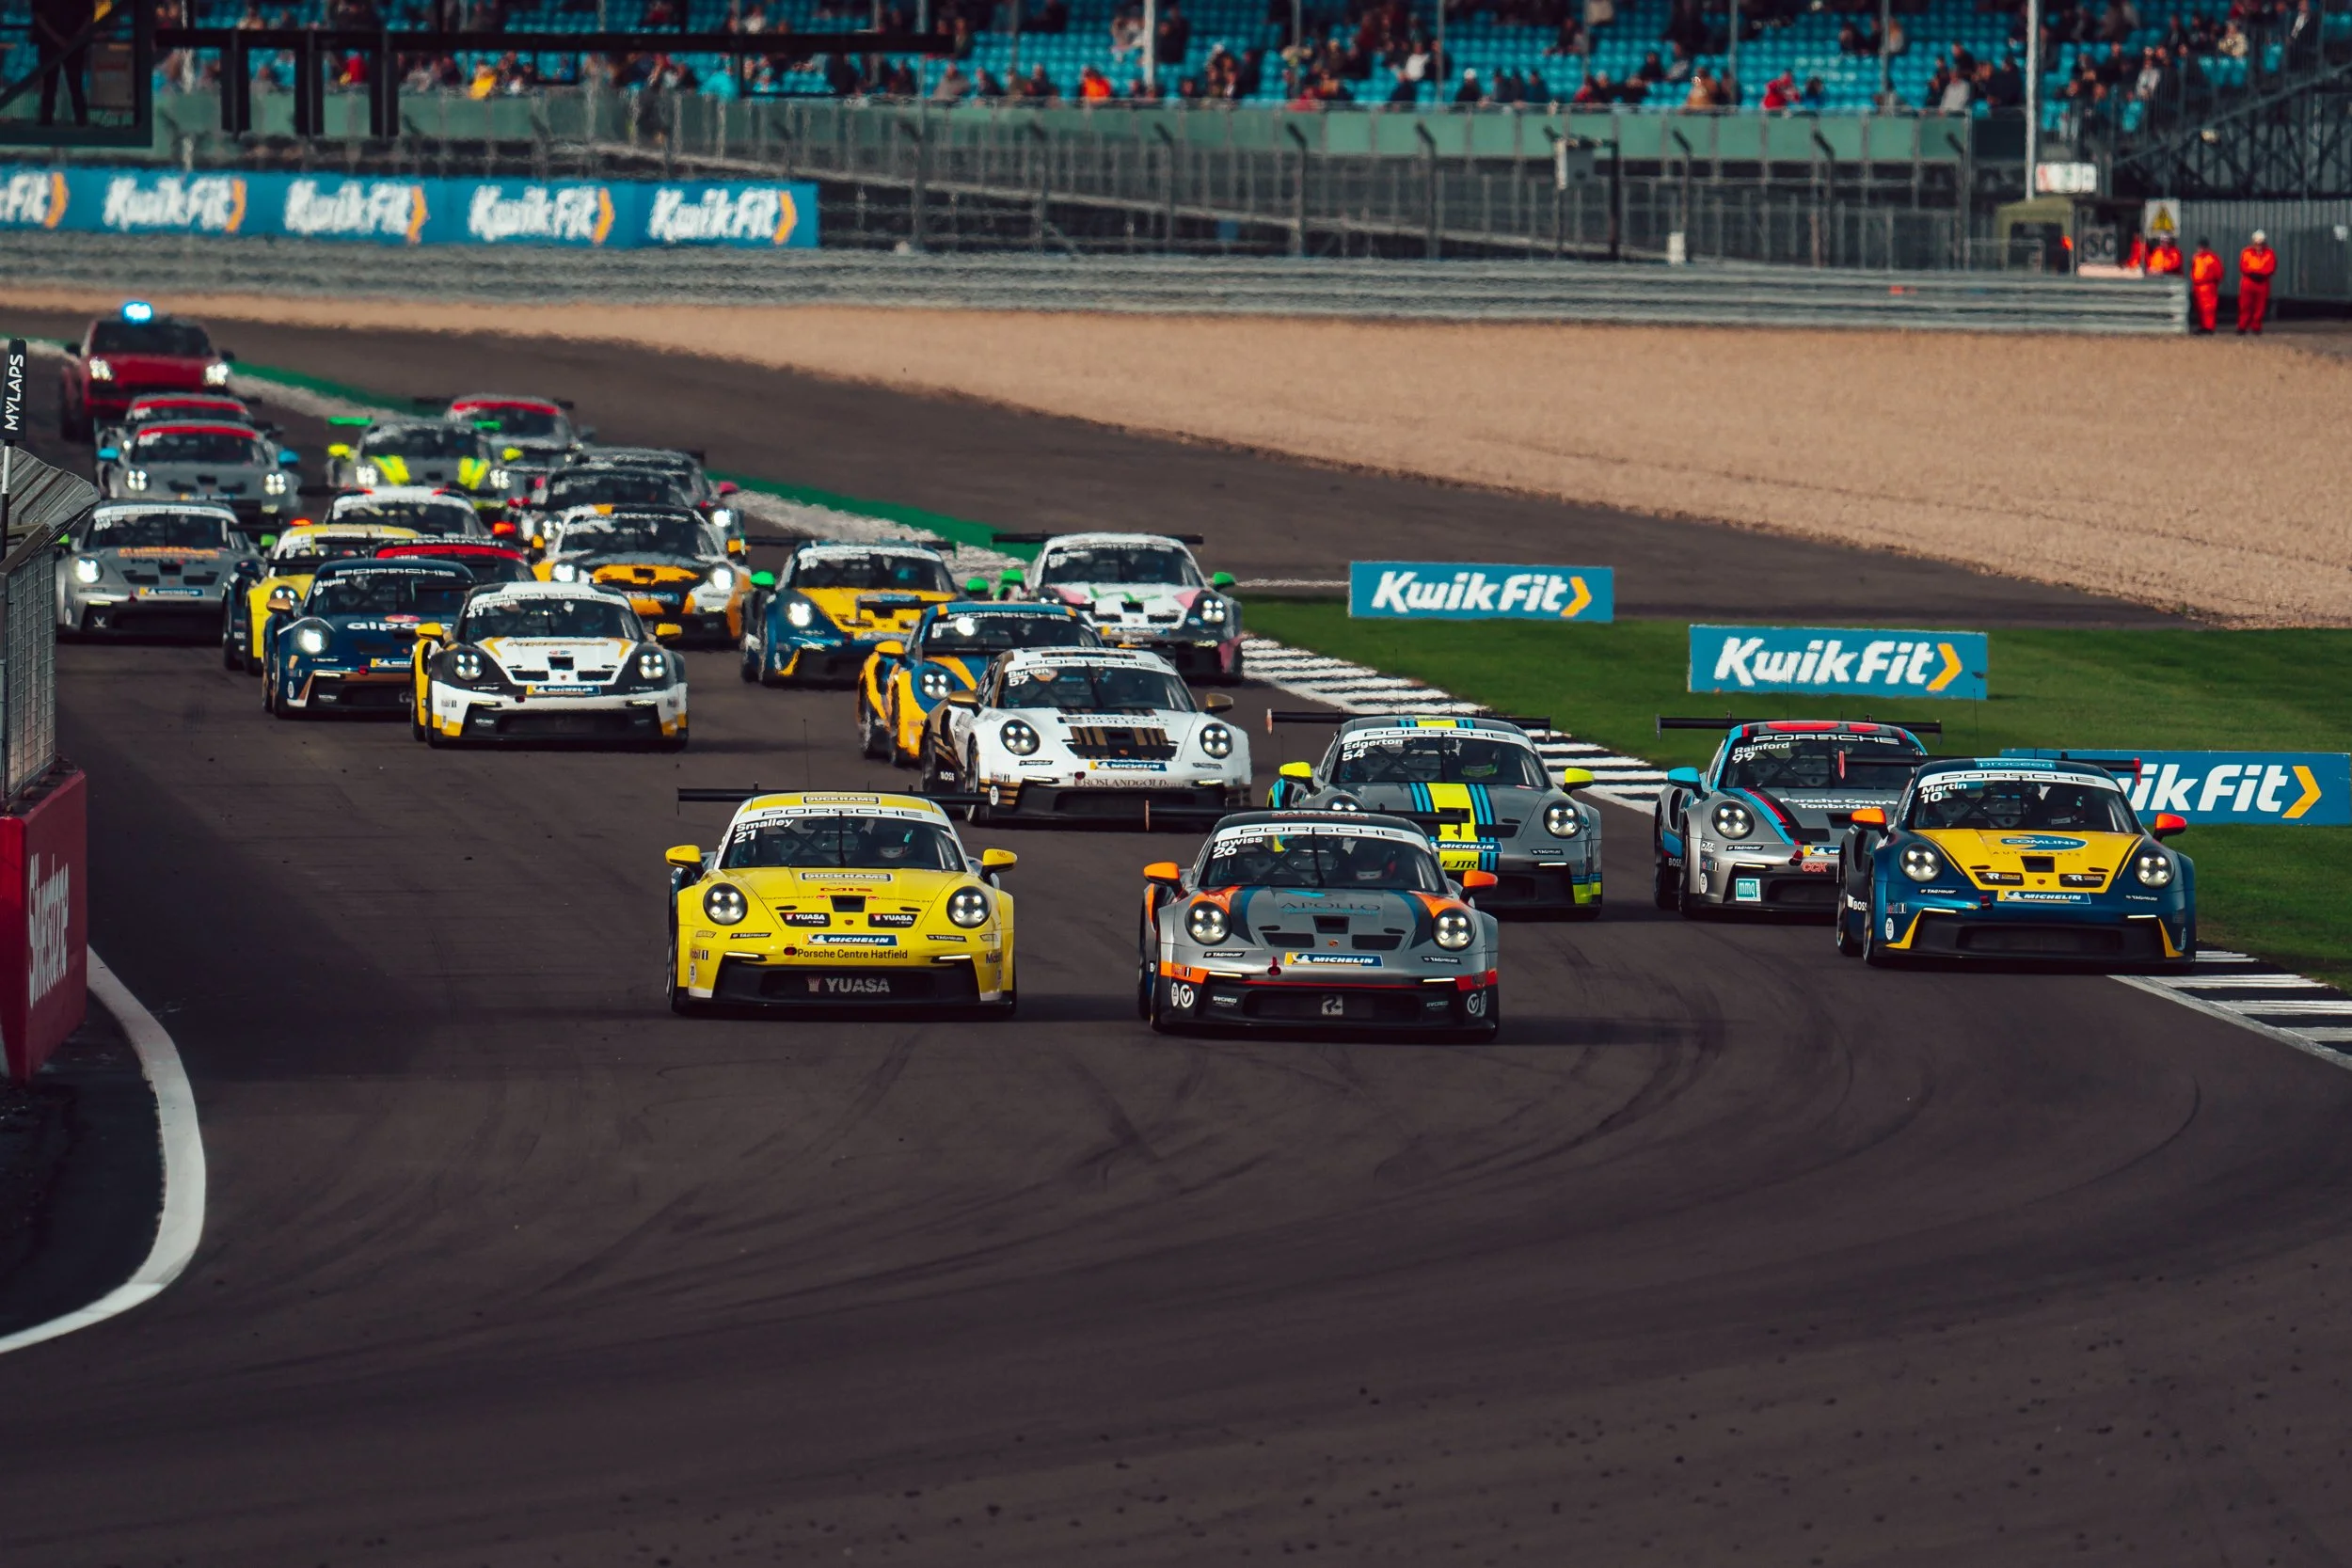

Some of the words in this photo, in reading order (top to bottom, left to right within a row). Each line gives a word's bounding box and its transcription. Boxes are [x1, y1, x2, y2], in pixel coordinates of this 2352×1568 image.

[4, 354, 24, 431] MYLAPS
[1008, 667, 1050, 678] Burton
[1009, 675, 1031, 687] 57
[1364, 729, 1511, 741] PORSCHE
[1753, 734, 1900, 746] PORSCHE
[1343, 737, 1404, 752] Edgerton
[1734, 741, 1790, 754] Rainford
[1342, 750, 1366, 762] 54
[1732, 752, 1756, 764] 99
[1978, 761, 2053, 769] proceed
[1941, 772, 2096, 784] PORSCHE
[1920, 782, 1967, 795] Martin
[1920, 791, 1943, 804] 10
[762, 807, 924, 819] PORSCHE
[736, 818, 794, 832] Smalley
[733, 830, 756, 845] 21
[1240, 826, 1406, 839] PORSCHE
[1215, 836, 1263, 848] Jewiss
[2005, 838, 2078, 847] COMLINE
[1213, 847, 1237, 859] 26
[1452, 860, 1477, 868] JTR
[1802, 862, 1829, 873] CCK
[804, 873, 889, 881] DUCKHAMS
[1280, 902, 1381, 911] APOLLO
[1852, 901, 1867, 911] BOSS
[797, 948, 835, 958] Porsche
[837, 949, 867, 958] Centre
[870, 949, 908, 959] Hatfield
[825, 977, 891, 993] YUASA
